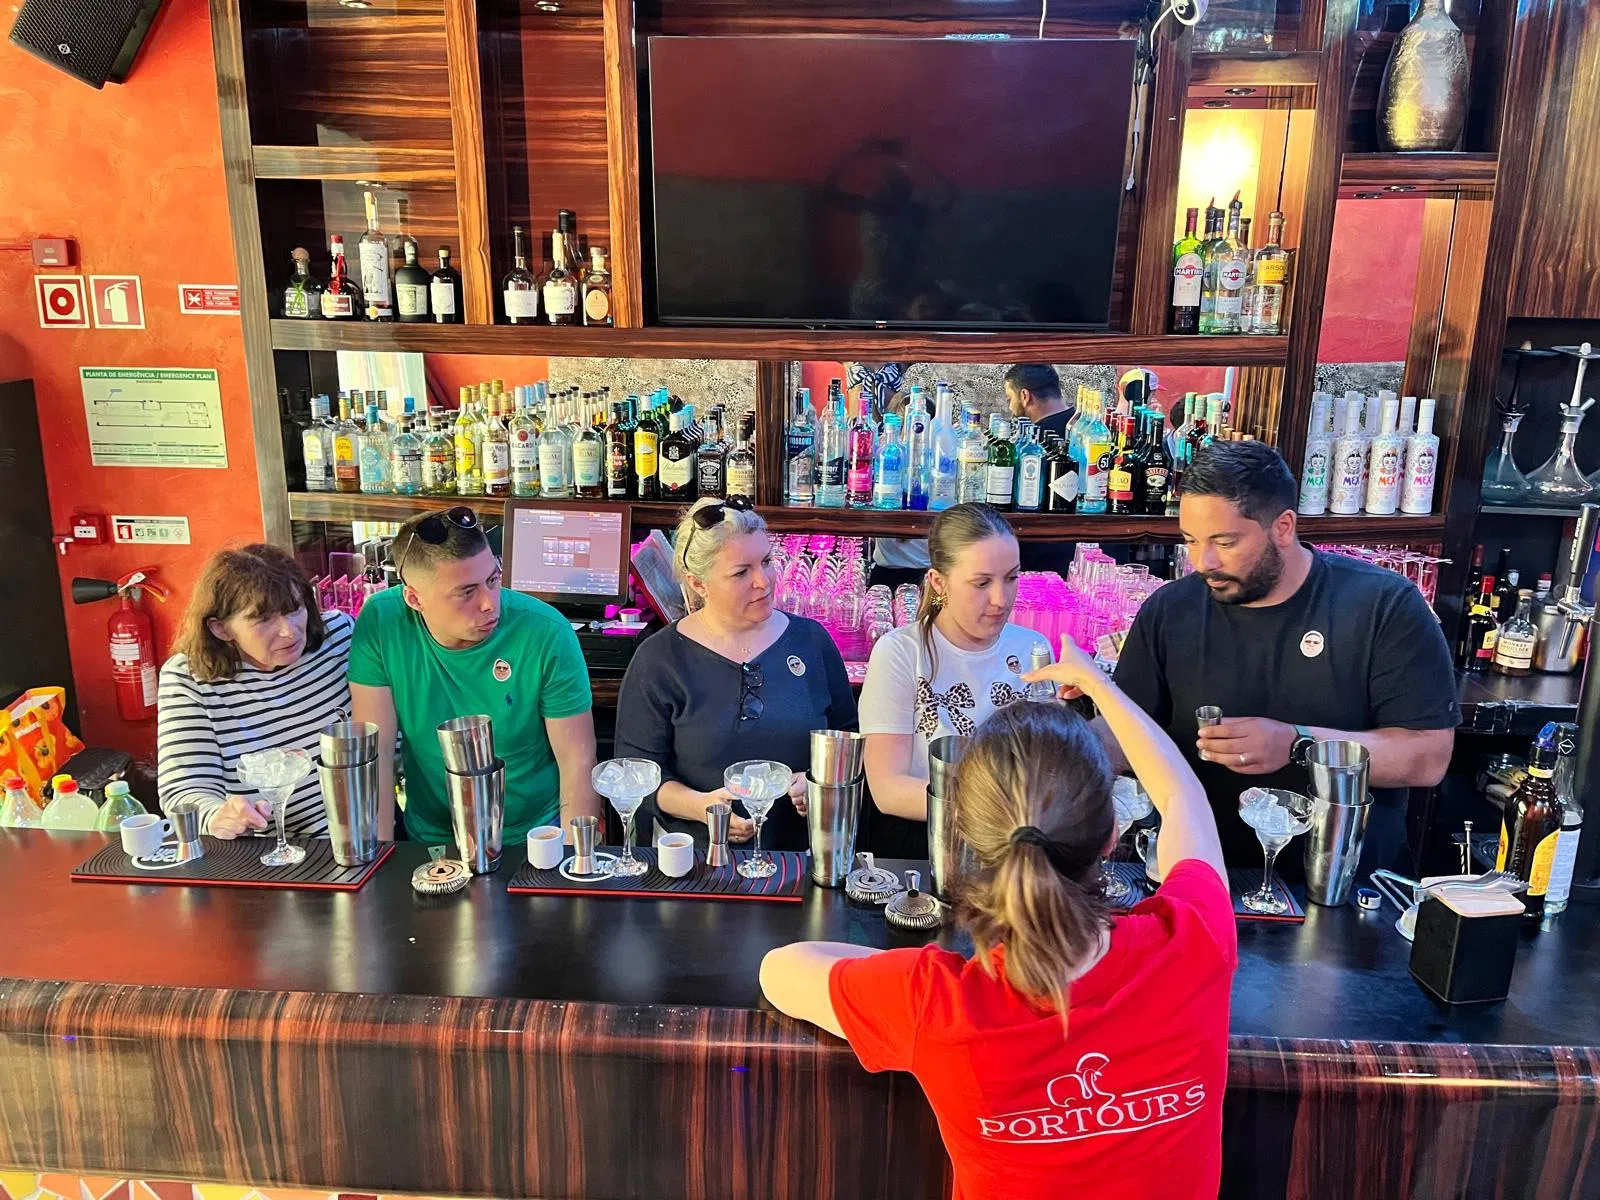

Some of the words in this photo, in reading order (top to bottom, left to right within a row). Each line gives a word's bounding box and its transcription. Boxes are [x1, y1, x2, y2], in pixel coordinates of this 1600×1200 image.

[1175, 268, 1202, 276] MARTINI
[1306, 476, 1324, 486] MEX
[1378, 476, 1396, 486] MEX
[1414, 476, 1433, 486] MEX
[976, 1083, 1206, 1137] PORTOURS
